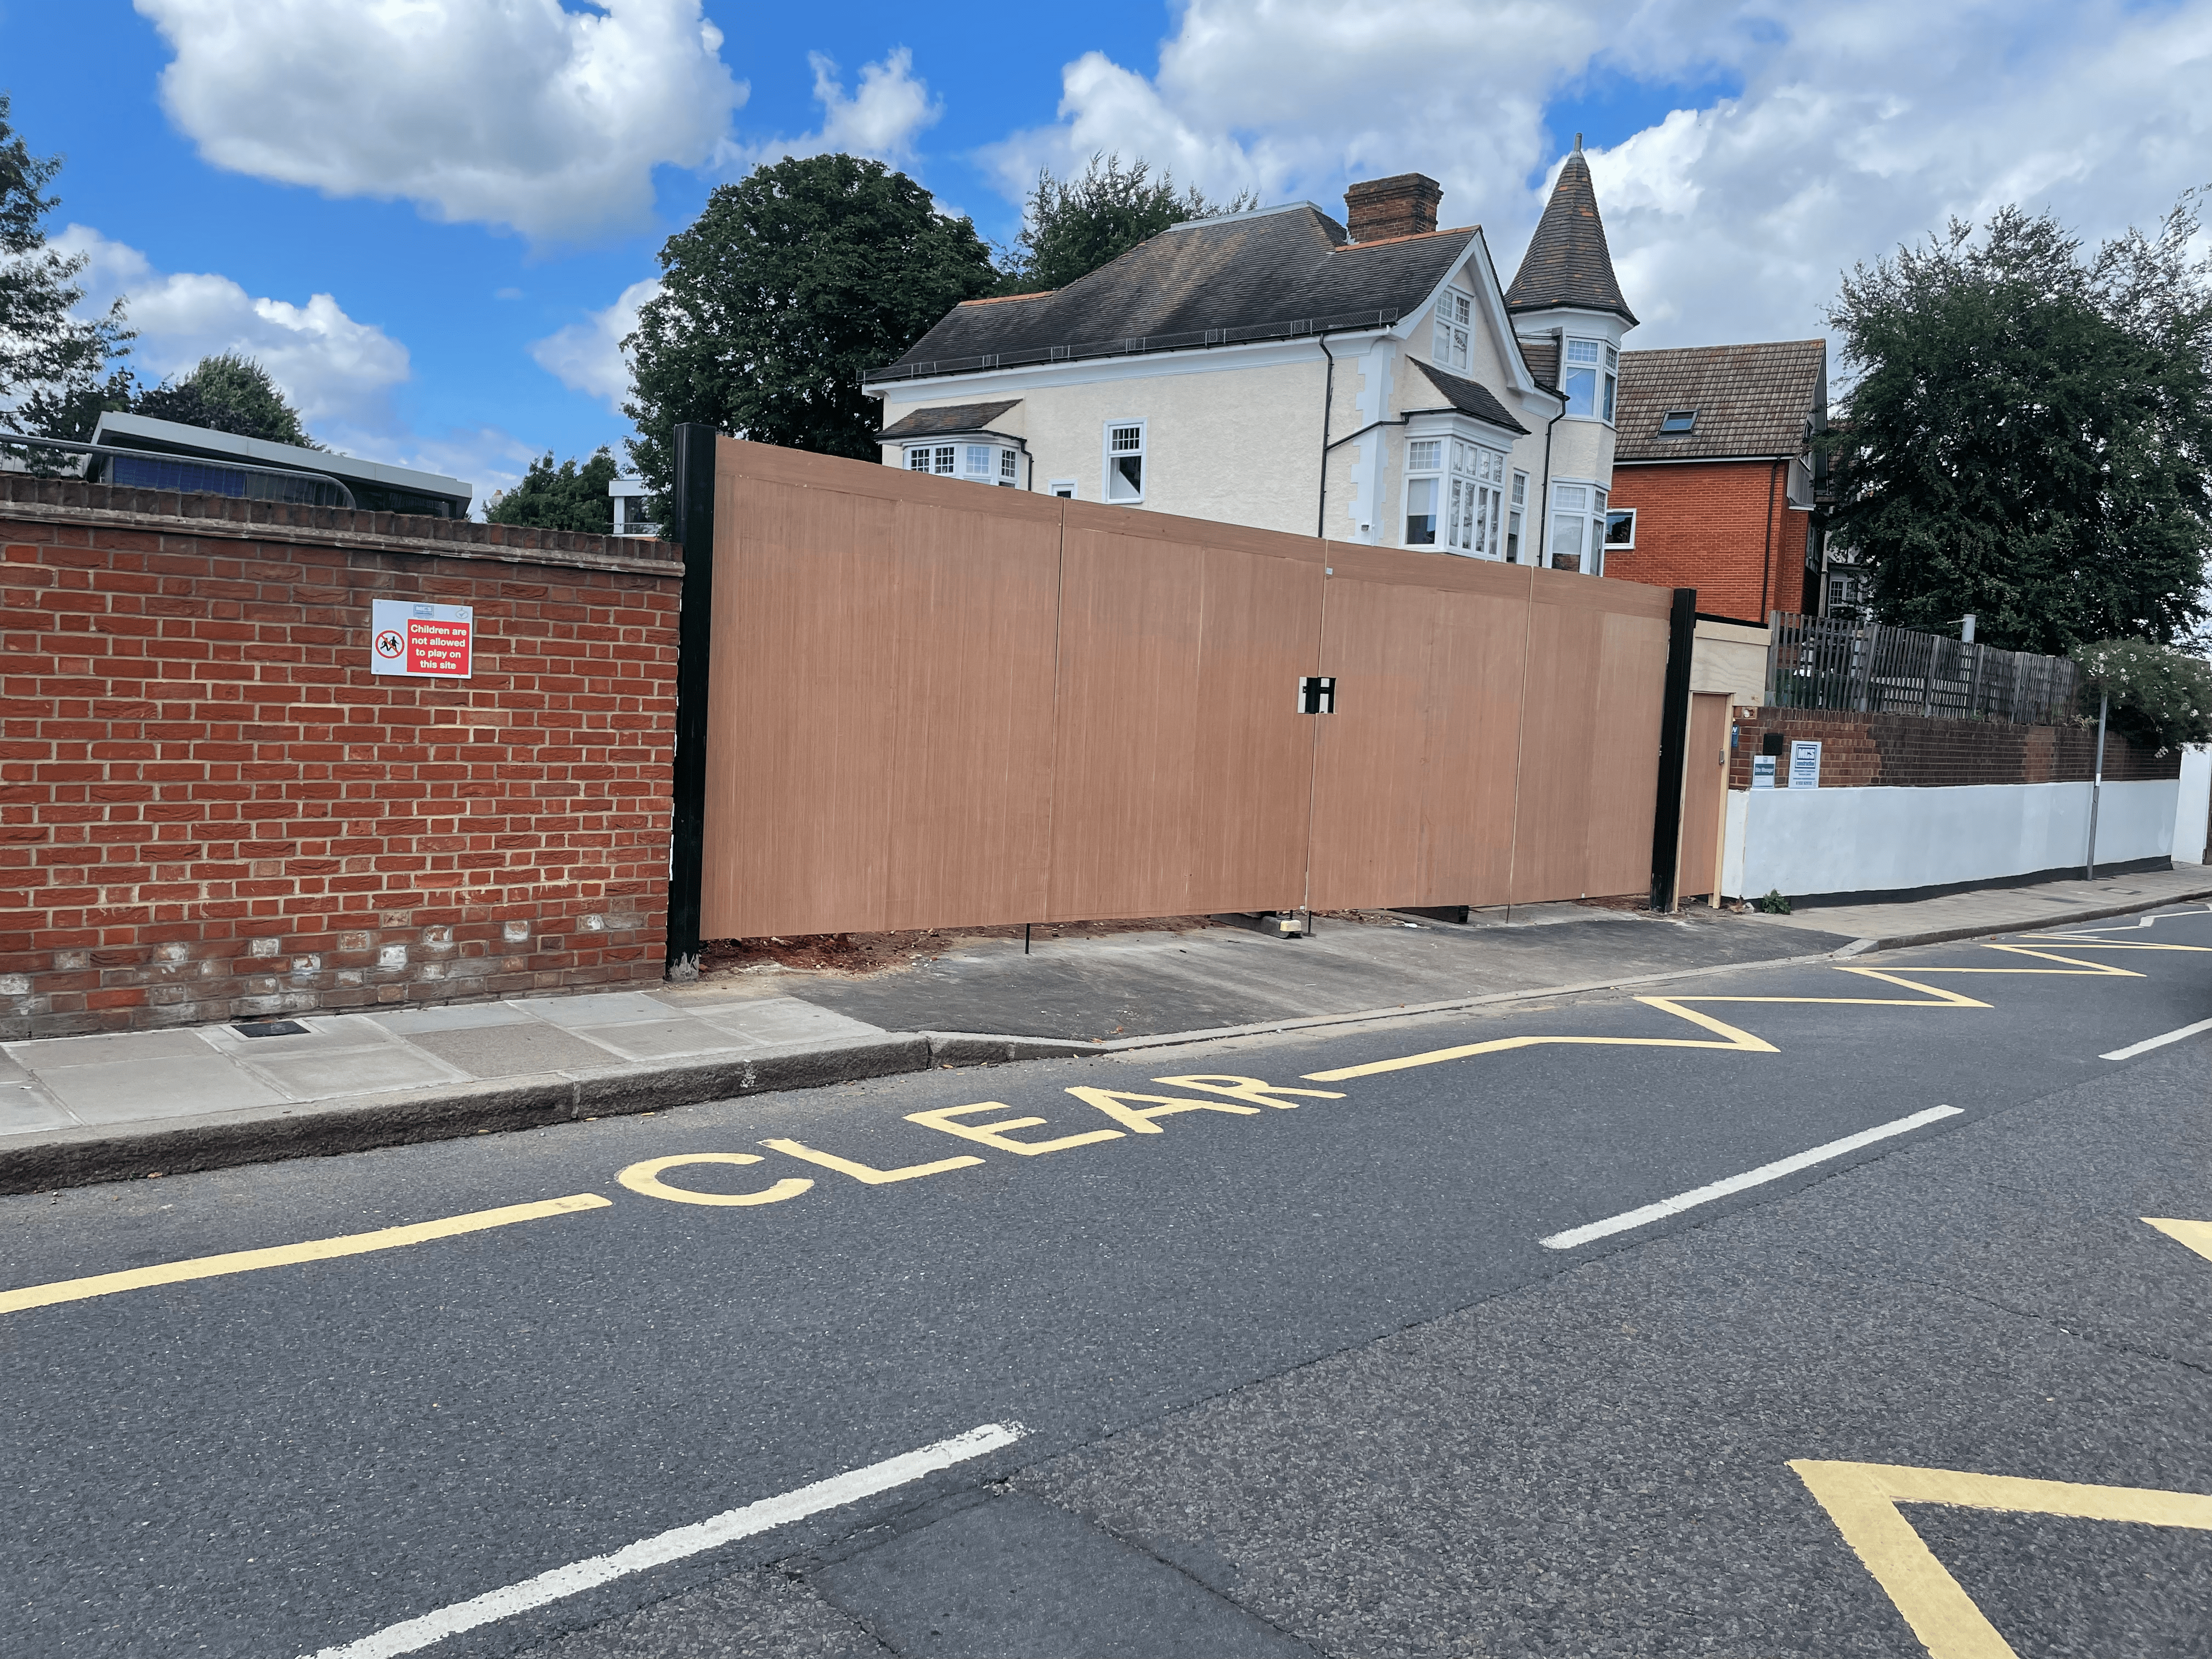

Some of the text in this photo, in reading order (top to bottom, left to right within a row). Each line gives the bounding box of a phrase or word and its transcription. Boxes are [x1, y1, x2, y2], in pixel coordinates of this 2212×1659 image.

[410, 624, 450, 635] Children
[411, 637, 466, 647] not allowed
[415, 648, 426, 656] to
[427, 648, 447, 659] play
[420, 659, 456, 669] this site
[1798, 748, 1815, 759] MCS
[614, 1074, 1347, 1206] CLEAR
